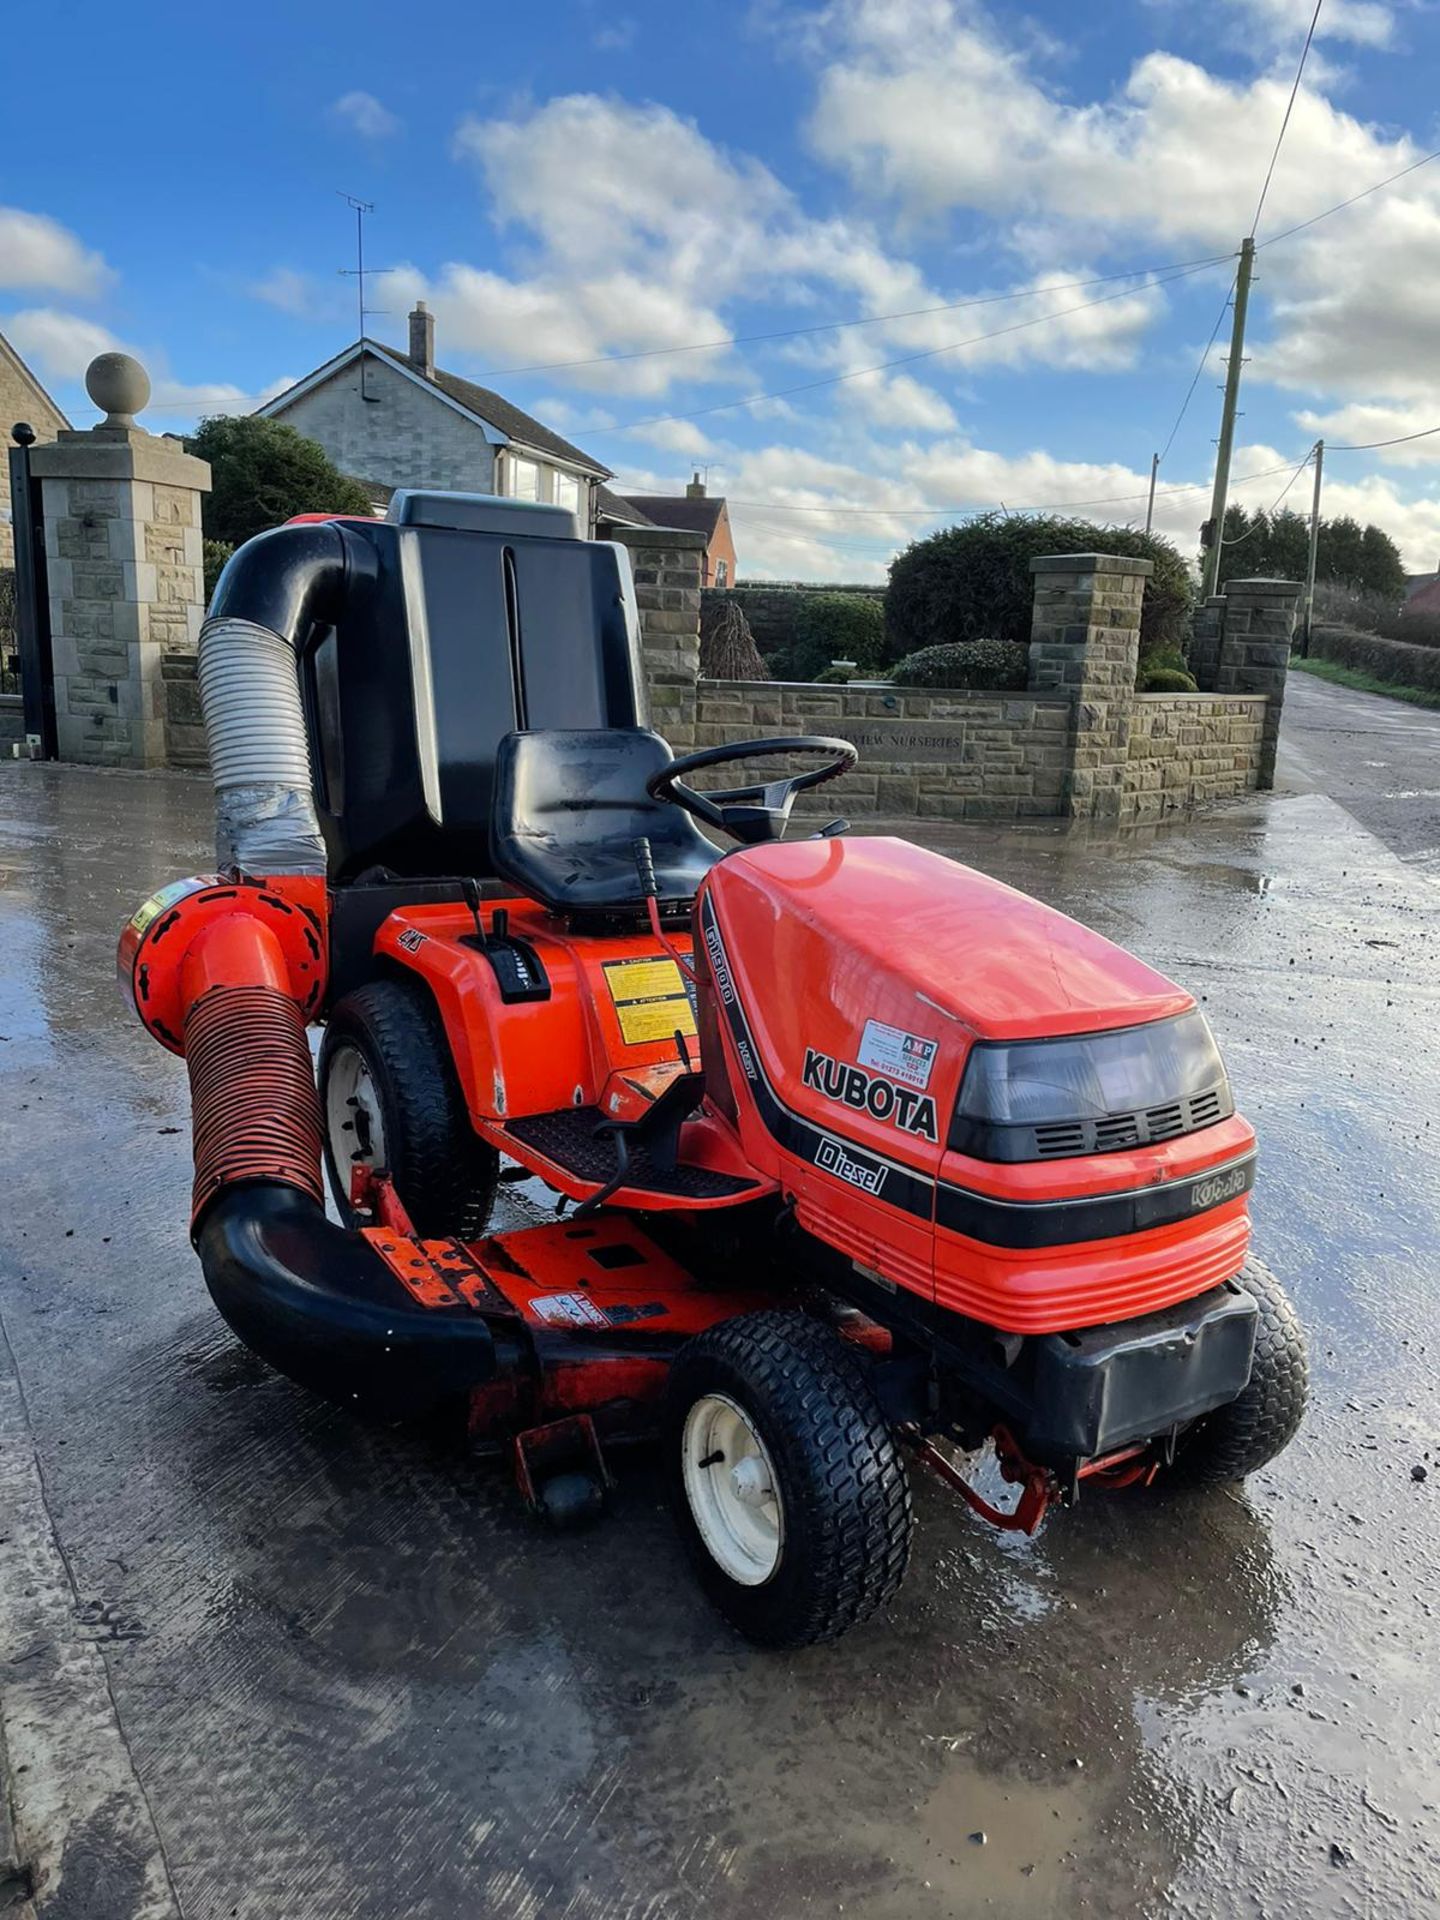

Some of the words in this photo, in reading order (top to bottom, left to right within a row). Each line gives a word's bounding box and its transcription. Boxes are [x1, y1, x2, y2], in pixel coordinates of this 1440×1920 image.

[853, 734, 885, 746] VIEW
[891, 736, 960, 748] NURSERIES
[705, 925, 734, 1004] G1900
[903, 1039, 932, 1056] AMP
[801, 1047, 939, 1143] KUBOTA
[814, 1137, 889, 1195] Diesel
